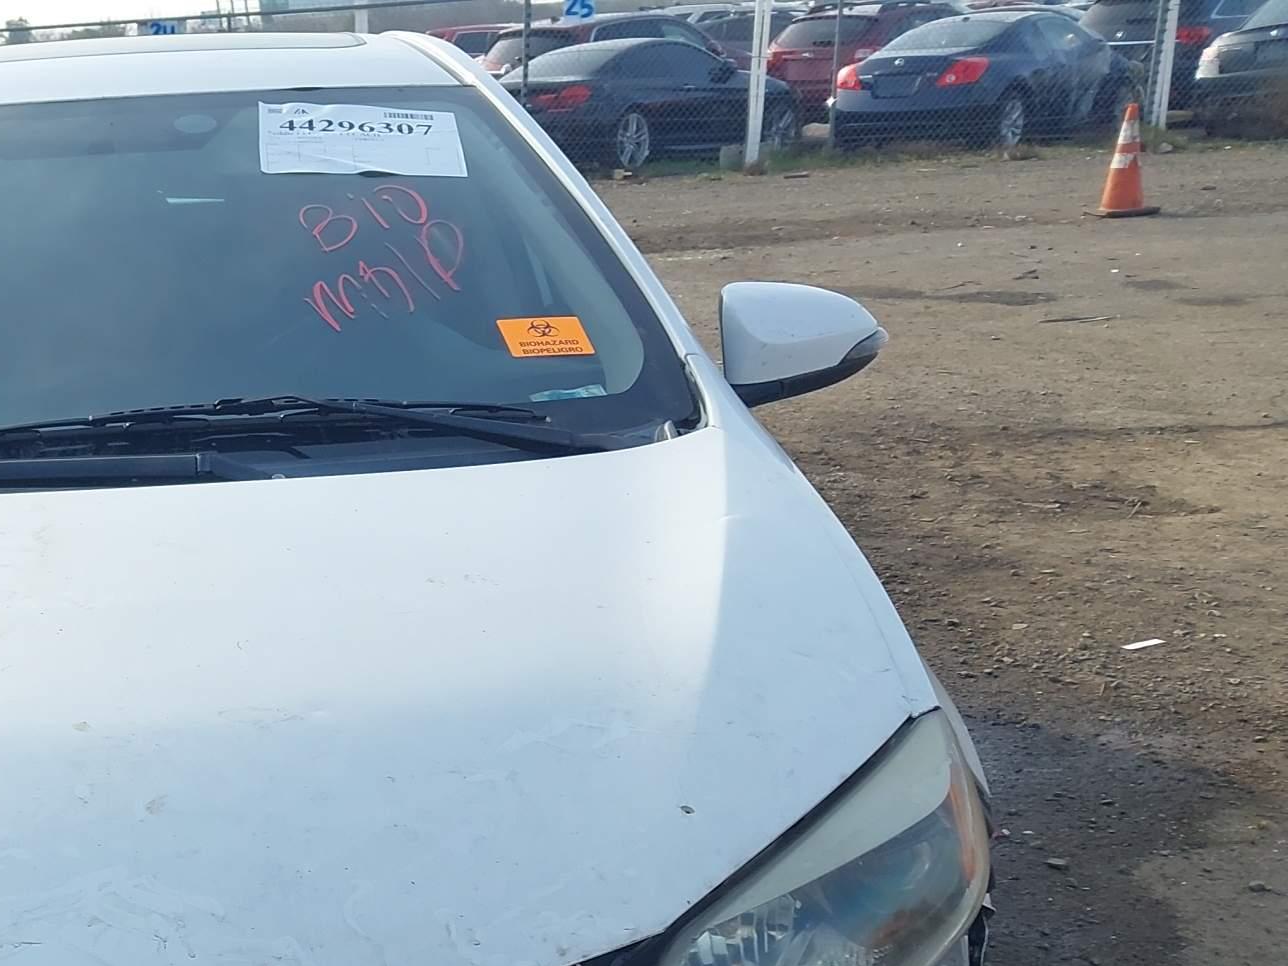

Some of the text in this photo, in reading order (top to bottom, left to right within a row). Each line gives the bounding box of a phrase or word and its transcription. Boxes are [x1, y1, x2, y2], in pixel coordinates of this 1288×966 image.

[565, 0, 594, 18] 25
[279, 118, 433, 136] 44296307
[518, 339, 580, 348] BIOHAZARD
[521, 346, 584, 355] BIOPELIGRO
